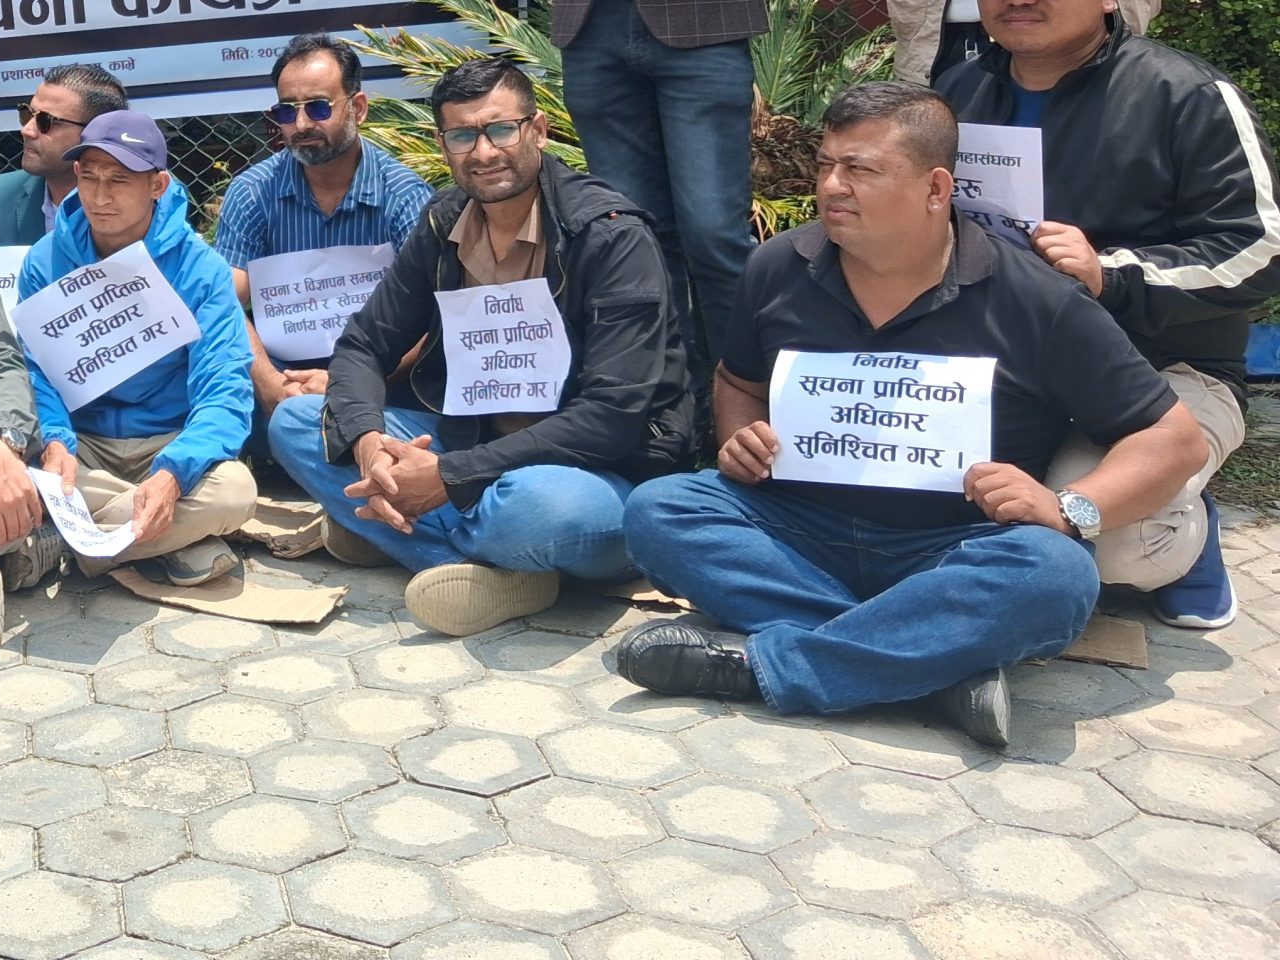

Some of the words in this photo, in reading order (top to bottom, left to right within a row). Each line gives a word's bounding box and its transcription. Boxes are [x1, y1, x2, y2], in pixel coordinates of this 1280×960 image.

[1, 67, 44, 83] प्रशासन
[259, 284, 290, 301] सूचना
[293, 283, 301, 295] र
[304, 275, 345, 292] विज्ञापन
[40, 303, 88, 338] सूचना
[89, 275, 151, 313] प्राप्तिको
[264, 298, 318, 319] विभेदकारी
[321, 299, 329, 310] र
[75, 302, 143, 348] अधिकार
[283, 317, 317, 335] निर्णय
[459, 328, 499, 350] सूचना
[502, 318, 553, 345] प्राप्तिको
[64, 336, 138, 385] सुनिश्चित
[139, 320, 168, 343] गर
[481, 350, 537, 371] अधिकार
[461, 379, 522, 406] सुनिश्चित
[526, 381, 548, 398] गर
[798, 375, 865, 396] सूचना
[873, 377, 967, 404] प्राप्तिको
[830, 402, 929, 432] अधिकार
[793, 430, 899, 461] सुनिश्चित
[907, 445, 945, 468] गर
